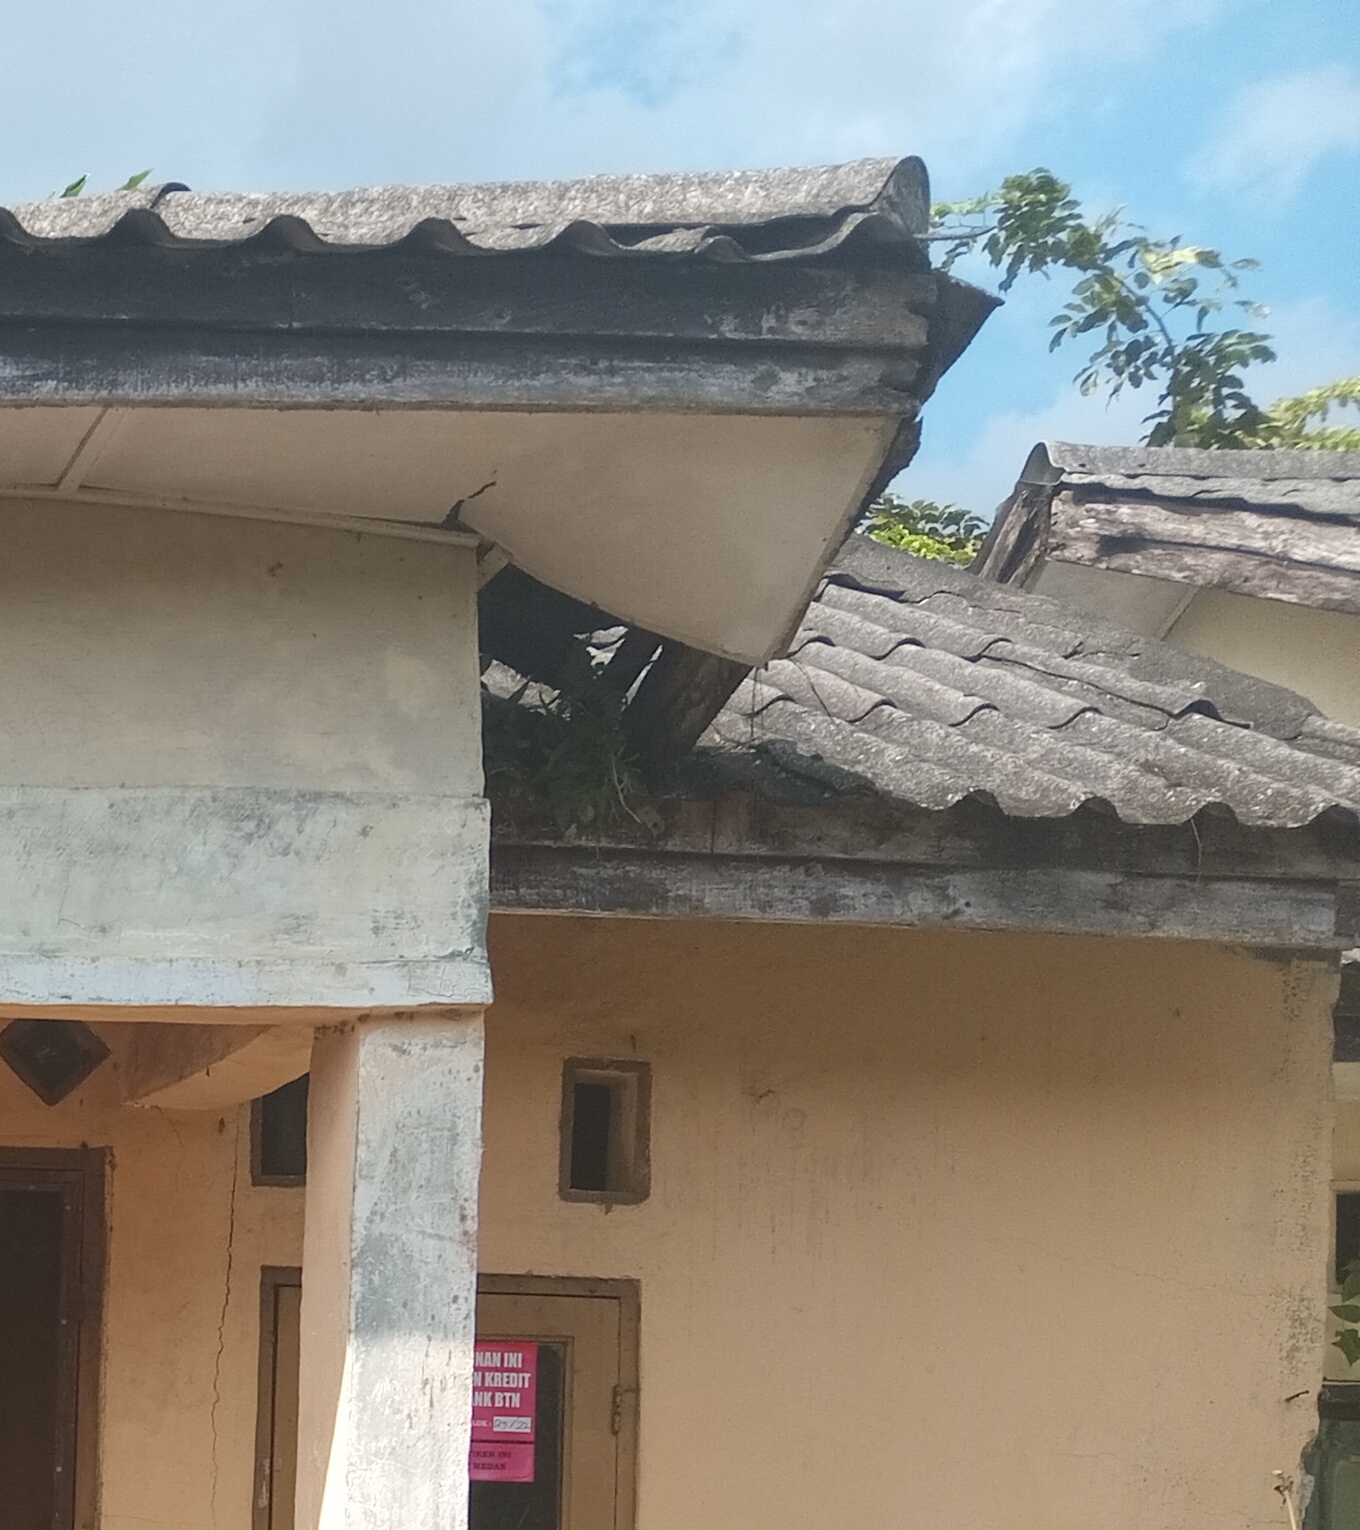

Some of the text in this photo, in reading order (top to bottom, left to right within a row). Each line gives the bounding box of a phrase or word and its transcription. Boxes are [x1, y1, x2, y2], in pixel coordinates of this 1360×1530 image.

[503, 1352, 523, 1368] INI
[484, 1371, 531, 1388] KREDIT
[473, 1391, 521, 1408] NK BTN
